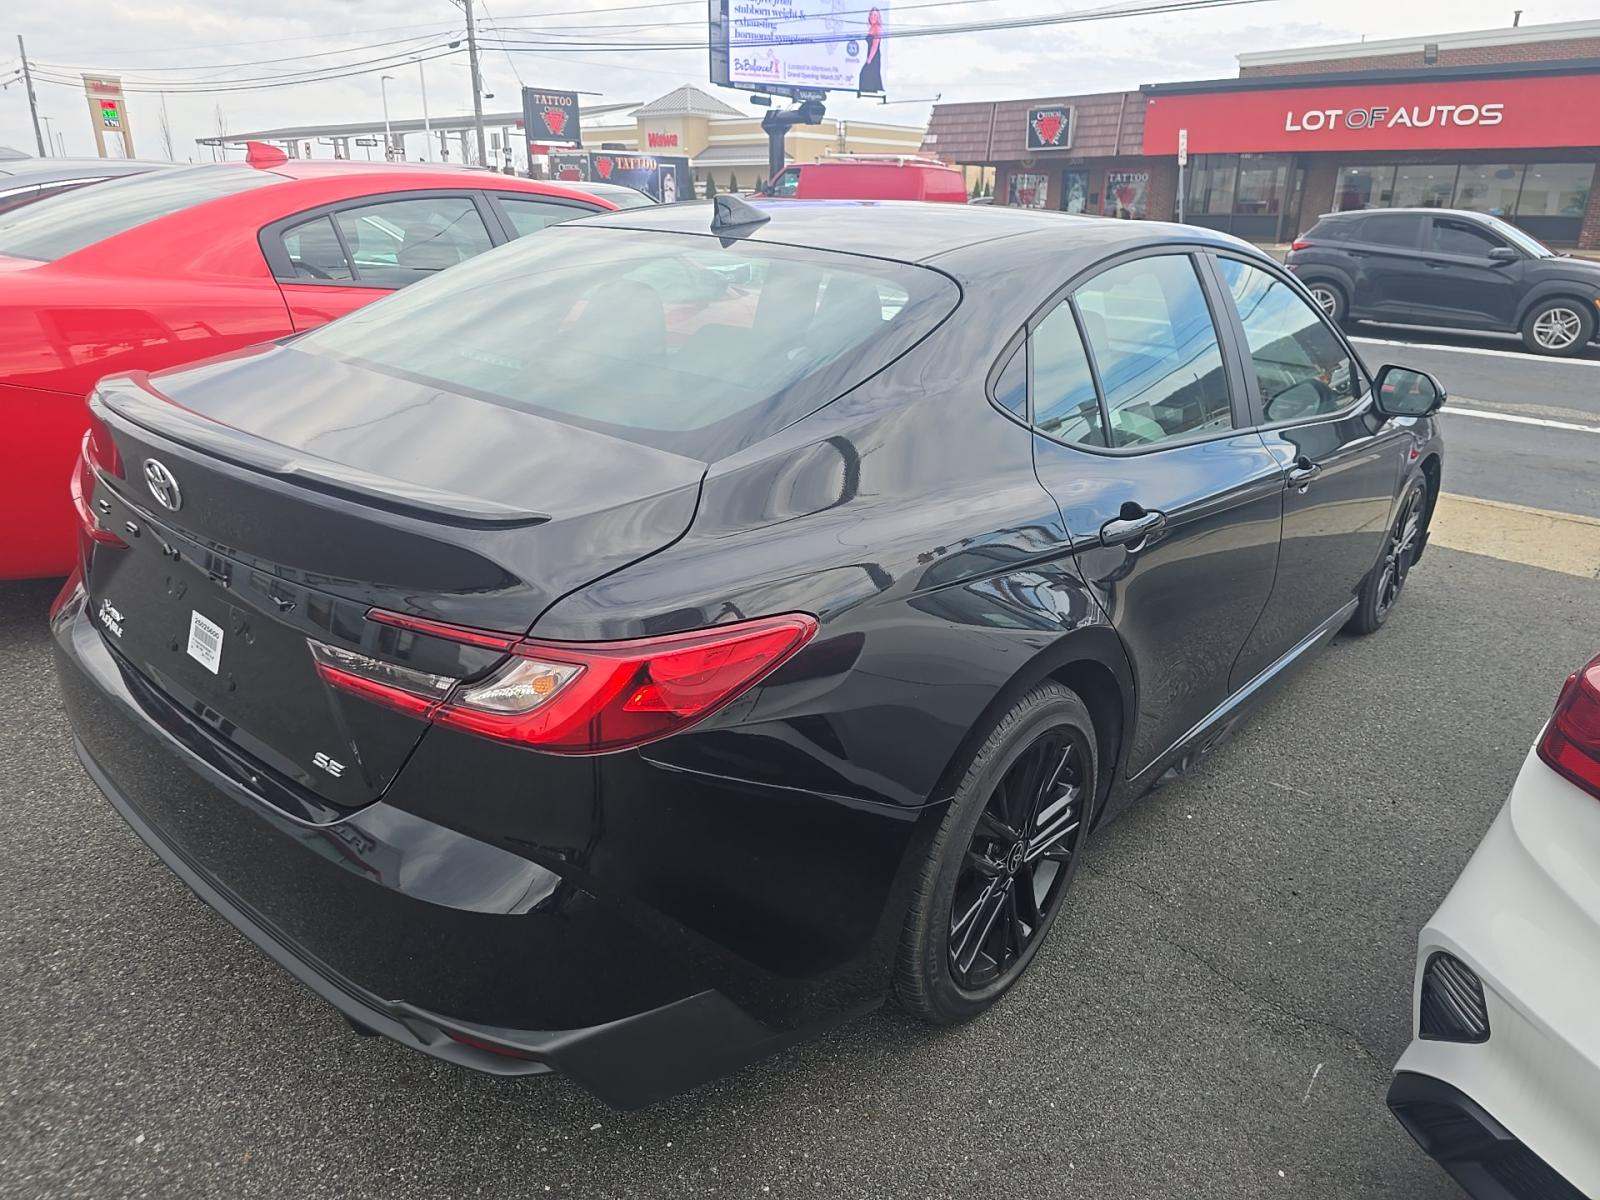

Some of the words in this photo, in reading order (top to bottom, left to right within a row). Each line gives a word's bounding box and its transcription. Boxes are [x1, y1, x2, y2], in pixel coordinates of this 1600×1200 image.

[734, 4, 771, 16] stubborn
[533, 94, 572, 106] TATTOO
[1285, 109, 1344, 131] LOT
[1344, 106, 1389, 130] OF
[1387, 103, 1504, 128] AUTOS
[648, 133, 678, 148] Wawa
[615, 157, 657, 171] TATTOO
[1109, 173, 1149, 183] TATTOO
[312, 752, 346, 778] SE
